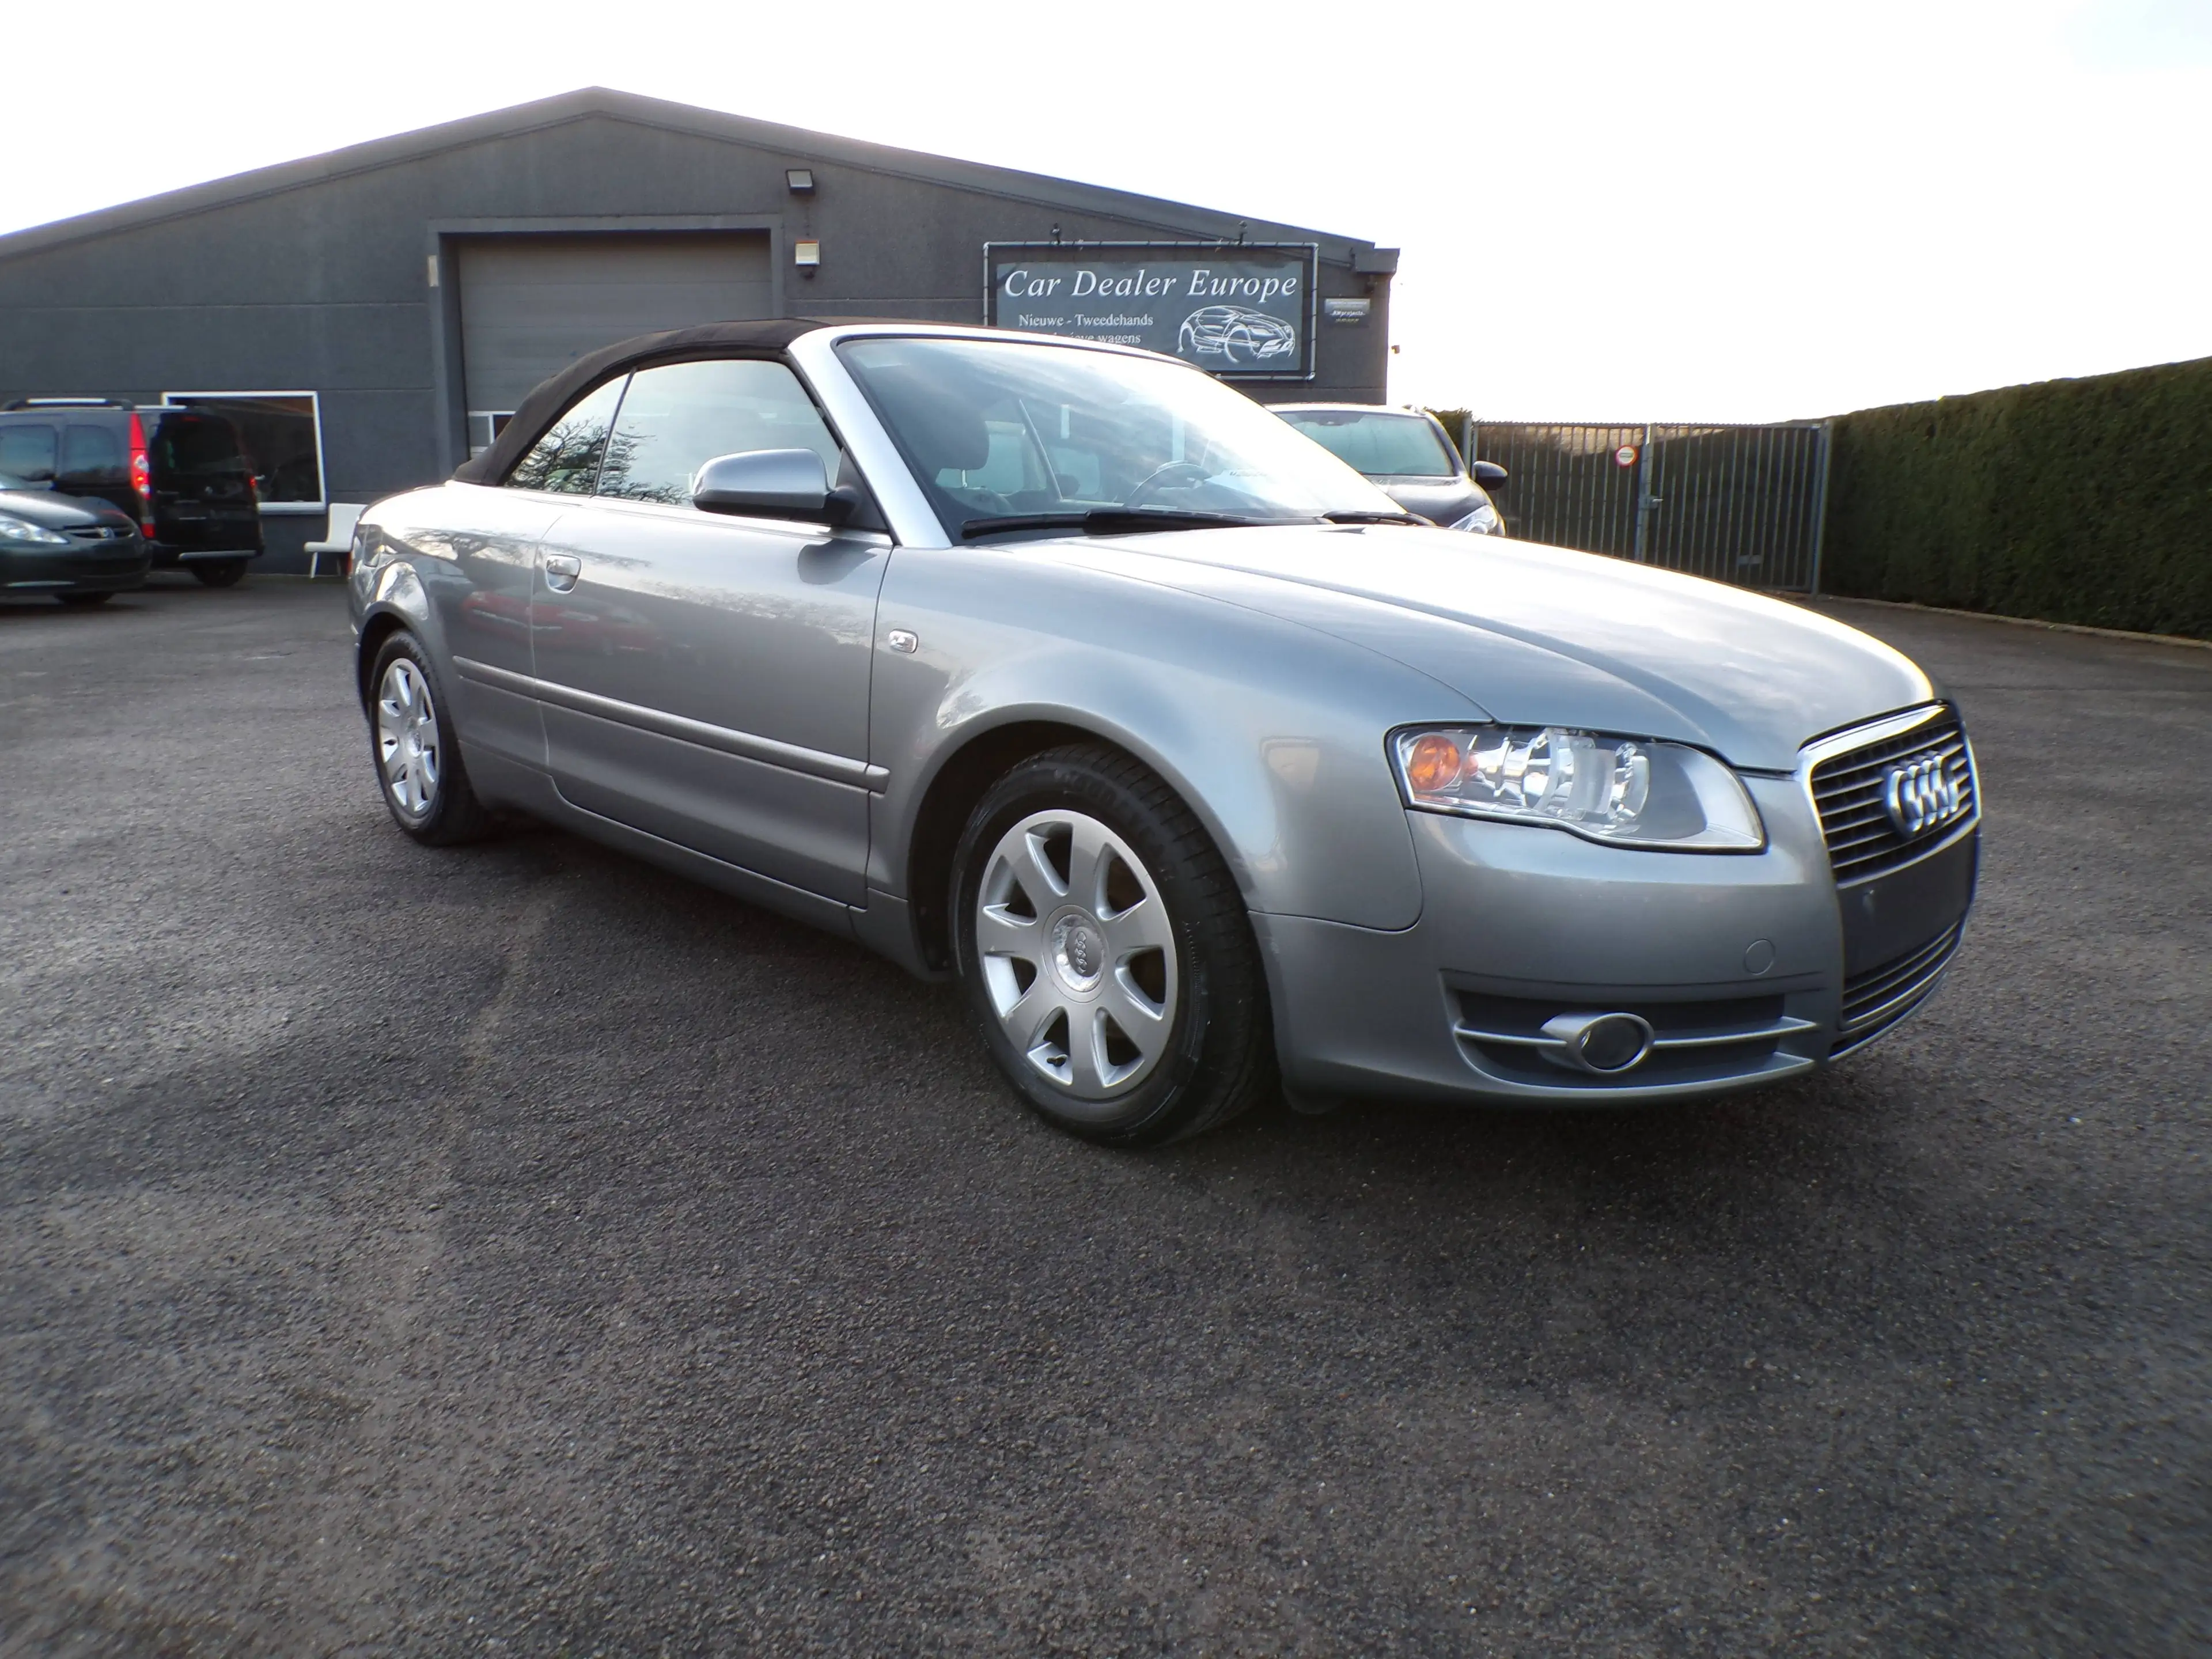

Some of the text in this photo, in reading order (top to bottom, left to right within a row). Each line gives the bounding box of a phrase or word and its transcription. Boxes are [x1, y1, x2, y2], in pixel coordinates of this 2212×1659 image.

[1005, 269, 1297, 303] Car Dealer Europe
[1018, 313, 1065, 327] Nieuwe
[1074, 313, 1153, 327] Tweedehands
[1097, 334, 1141, 344] wagens
